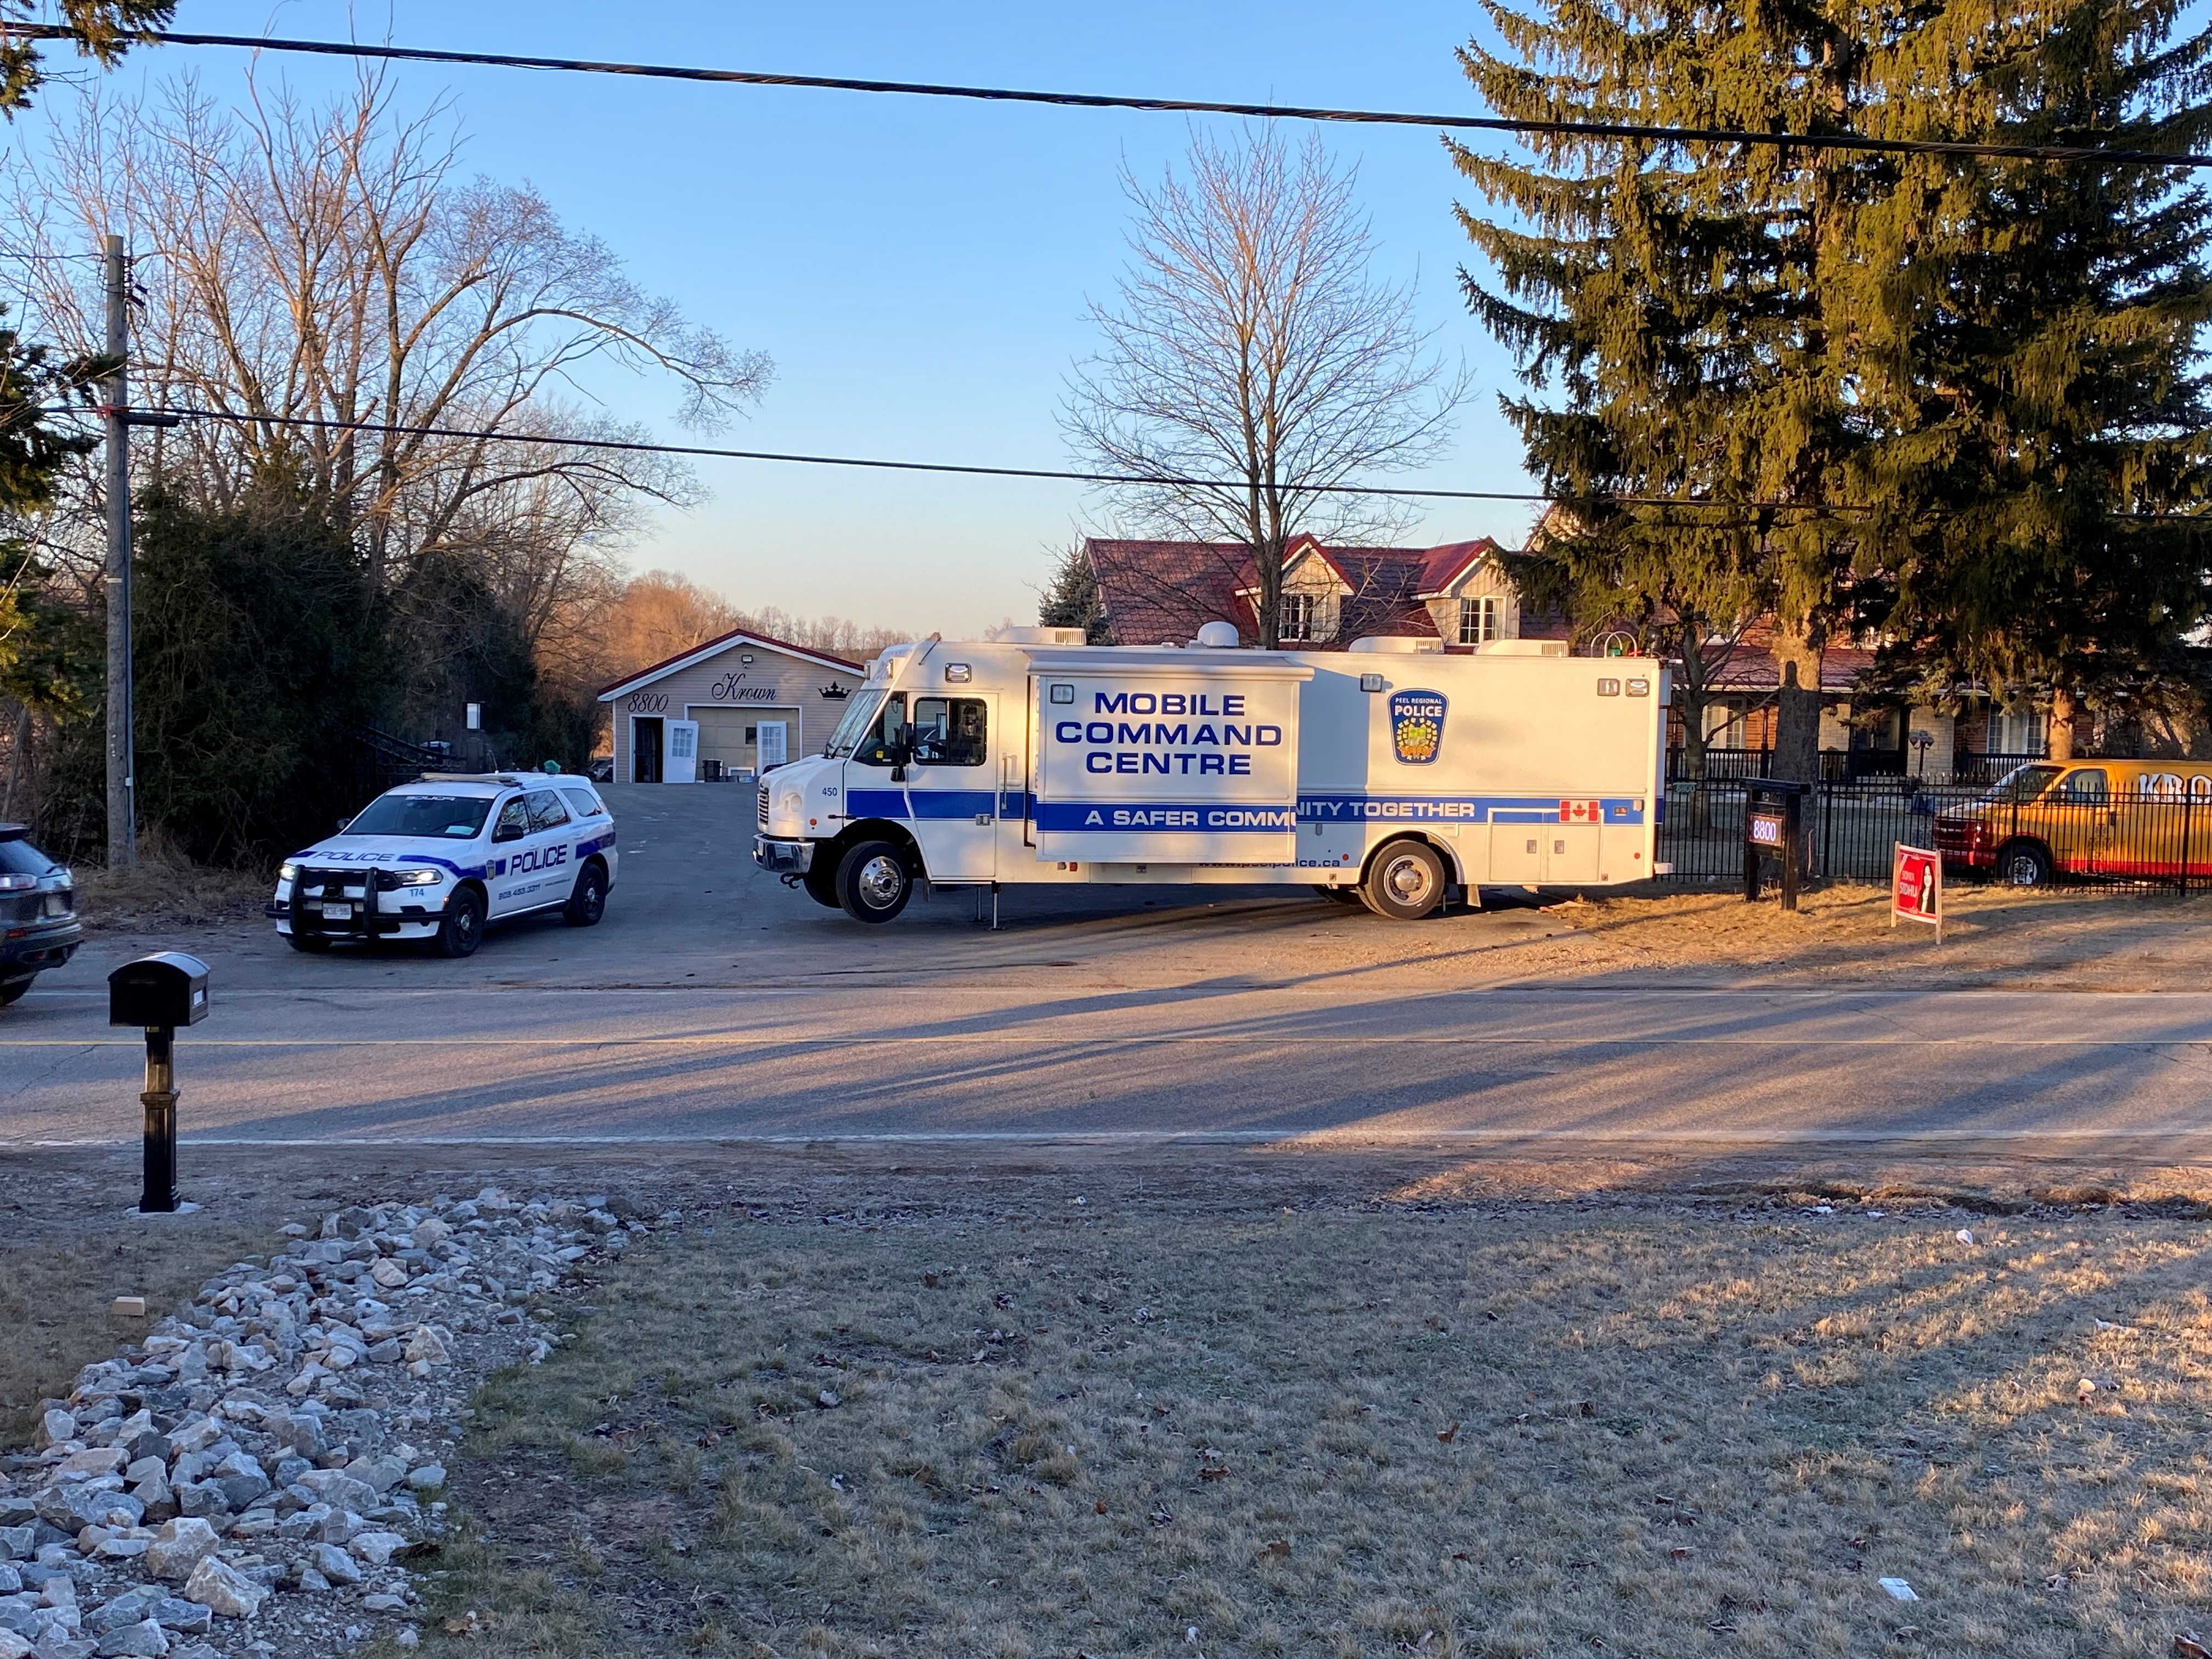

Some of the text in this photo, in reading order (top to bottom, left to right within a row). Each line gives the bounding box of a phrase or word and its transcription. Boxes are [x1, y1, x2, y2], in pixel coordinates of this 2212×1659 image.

[711, 673, 777, 700] Krown
[628, 693, 669, 712] 8800
[1095, 692, 1245, 716] MOBILE
[1394, 705, 1442, 716] POLICE
[1056, 721, 1282, 746] COMMAND
[1086, 752, 1251, 775] CENTRE
[822, 787, 837, 796] 450
[1085, 810, 1104, 825] A
[1113, 810, 1199, 826] SAFER
[1349, 802, 1475, 817] TOGETHER
[1754, 820, 1776, 842] 8800
[312, 851, 395, 861] POLICE
[510, 844, 568, 877] POLICE
[409, 888, 425, 896] 174
[1899, 882, 1918, 898] SIDHU
